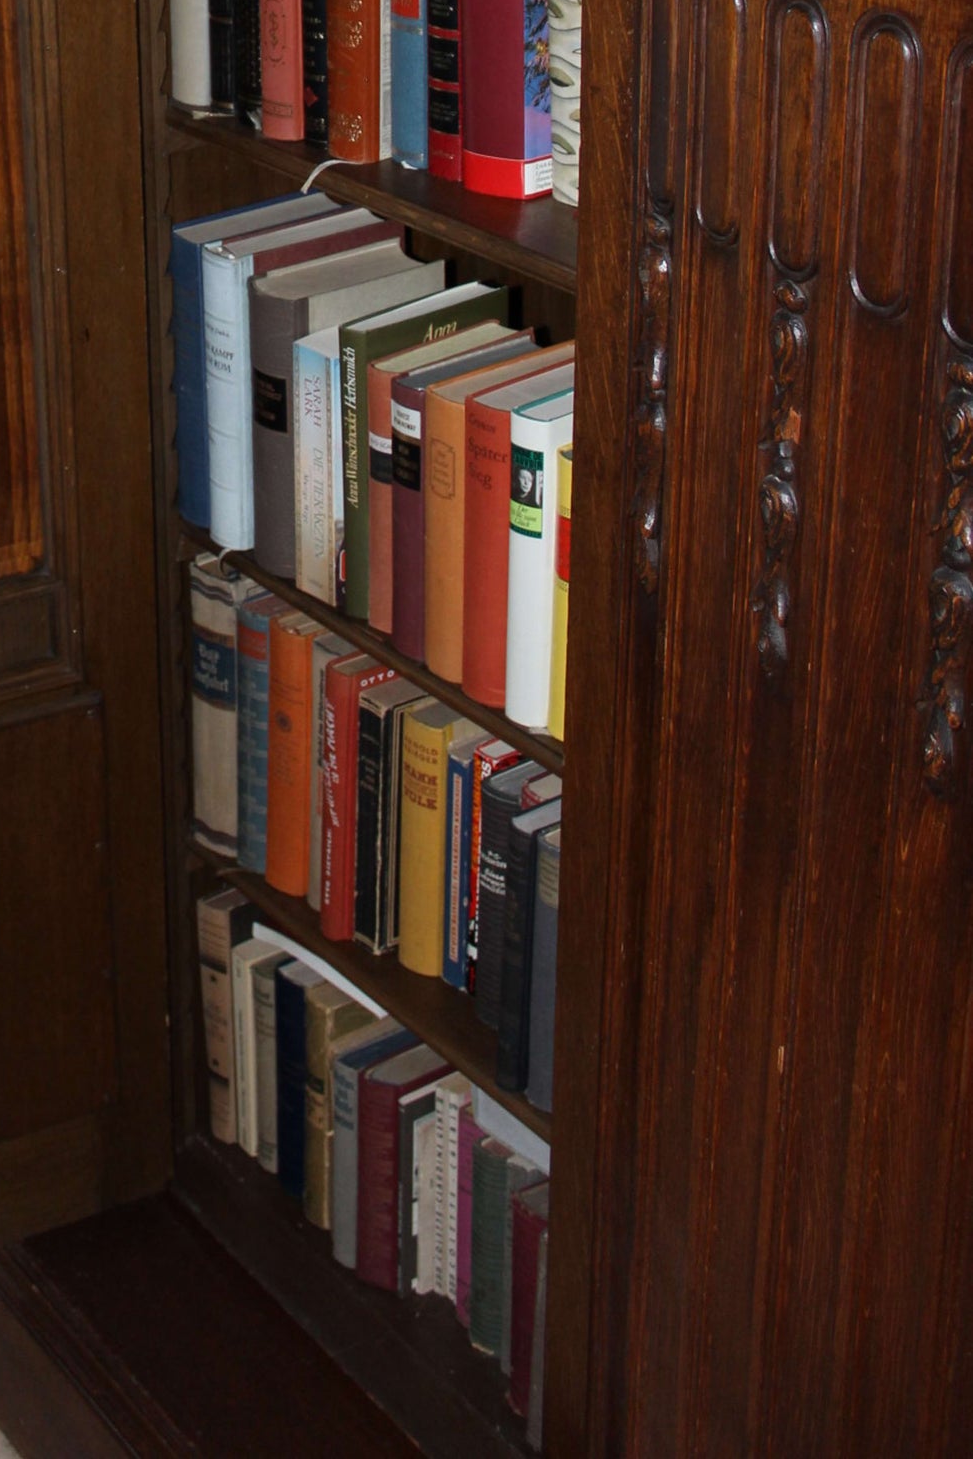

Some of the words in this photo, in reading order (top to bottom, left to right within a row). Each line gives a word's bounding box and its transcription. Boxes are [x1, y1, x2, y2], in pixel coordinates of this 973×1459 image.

[423, 320, 458, 342] Anna
[343, 347, 357, 409] Herbstmilch
[304, 377, 313, 416] LARK
[313, 375, 323, 427] SARAH
[468, 437, 508, 464] Später
[359, 669, 396, 687] OTTO
